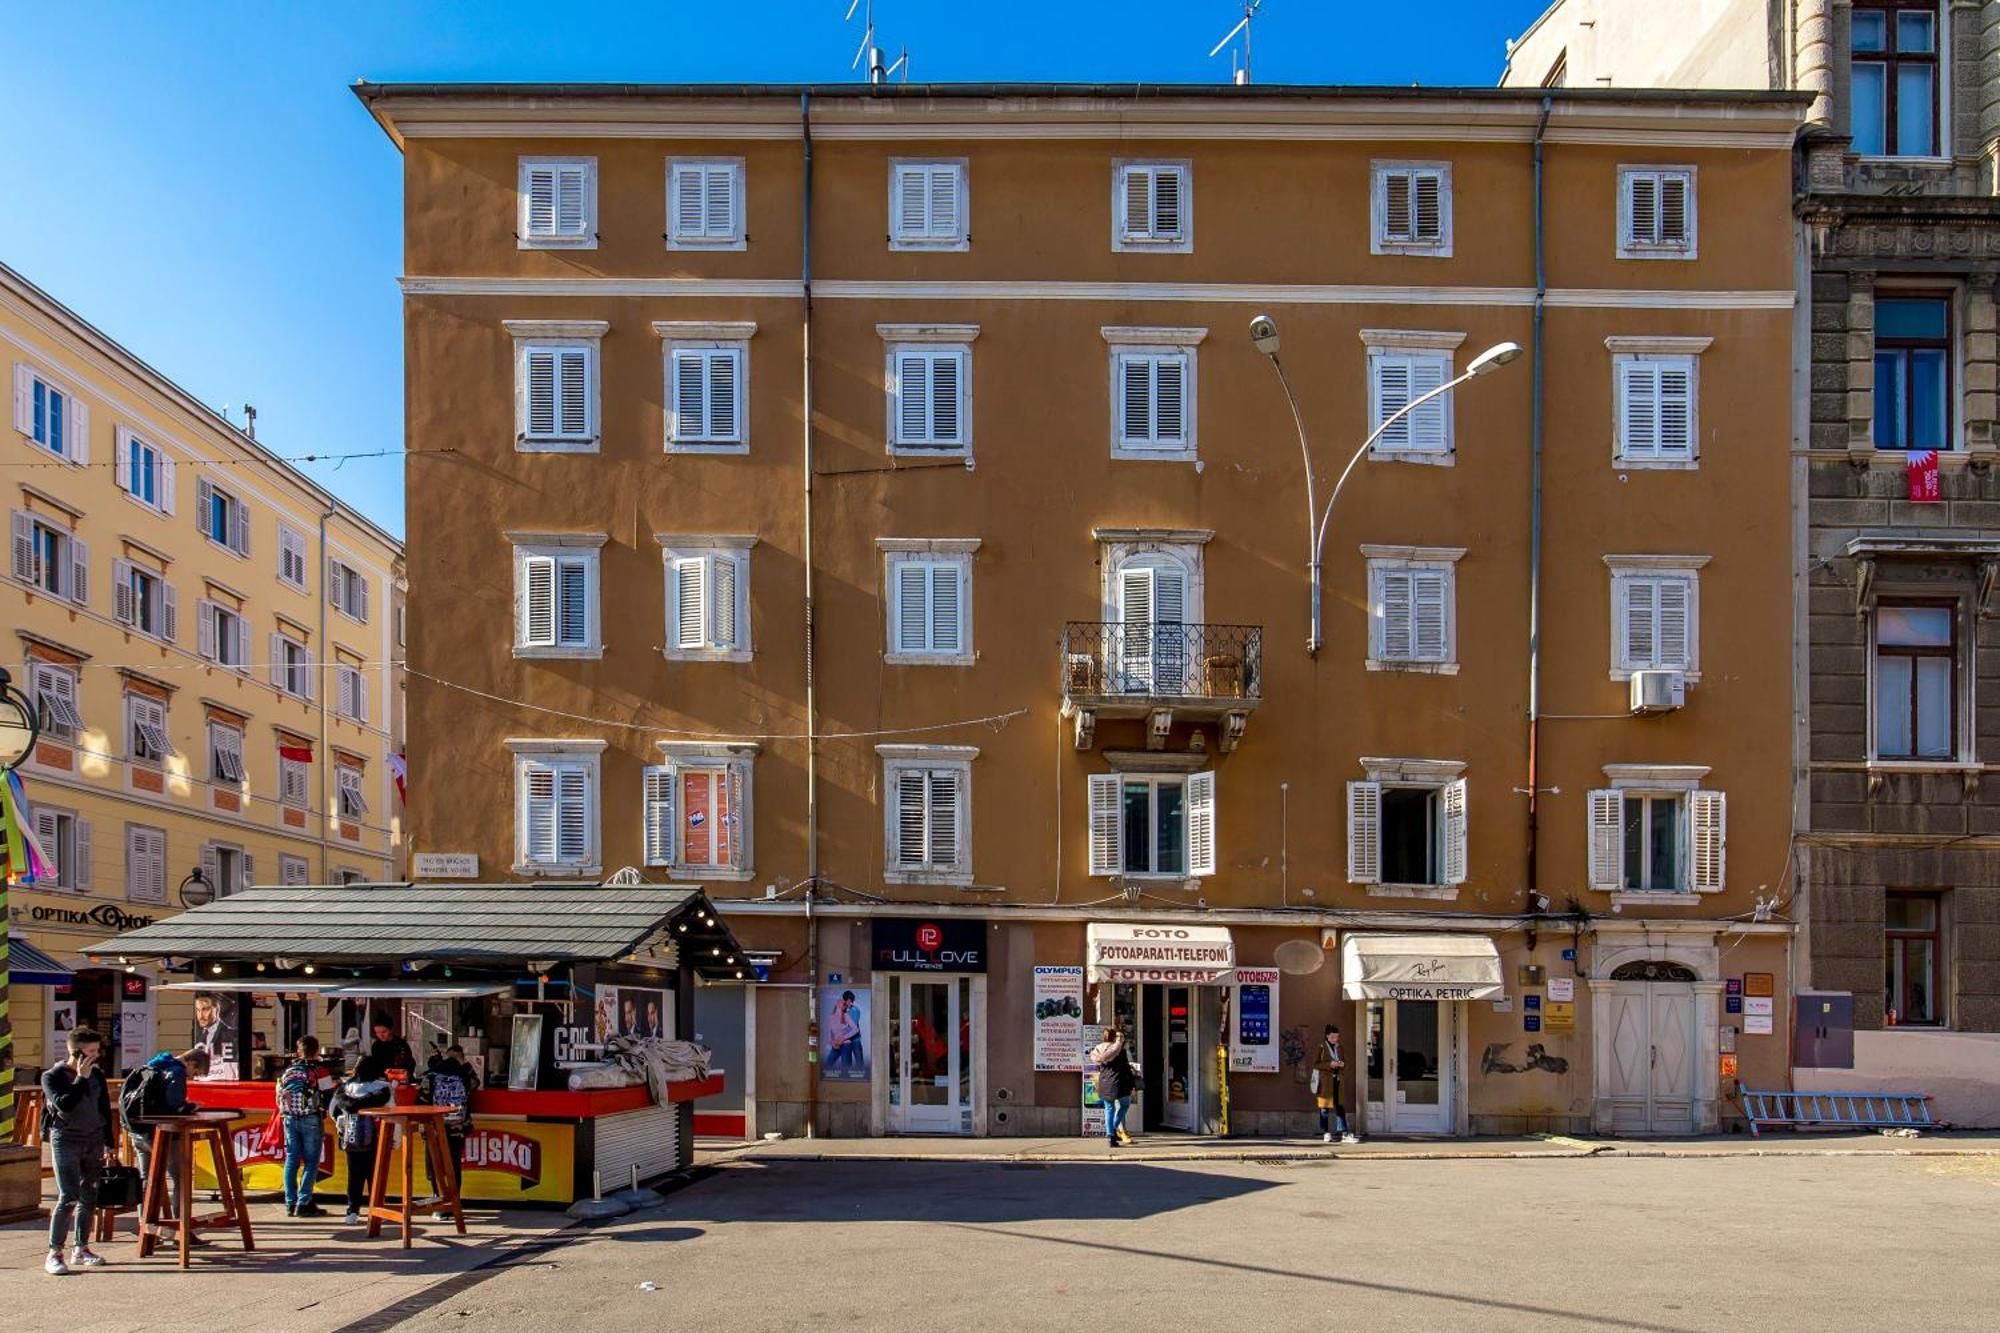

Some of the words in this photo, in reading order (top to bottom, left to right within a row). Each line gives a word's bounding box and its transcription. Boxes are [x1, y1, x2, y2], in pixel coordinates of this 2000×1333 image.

[31, 906, 89, 925] OPTIKA
[1132, 928, 1190, 939] FOTO
[1035, 967, 1082, 975] OLYMPUS
[1388, 987, 1433, 1000] OPTIKA
